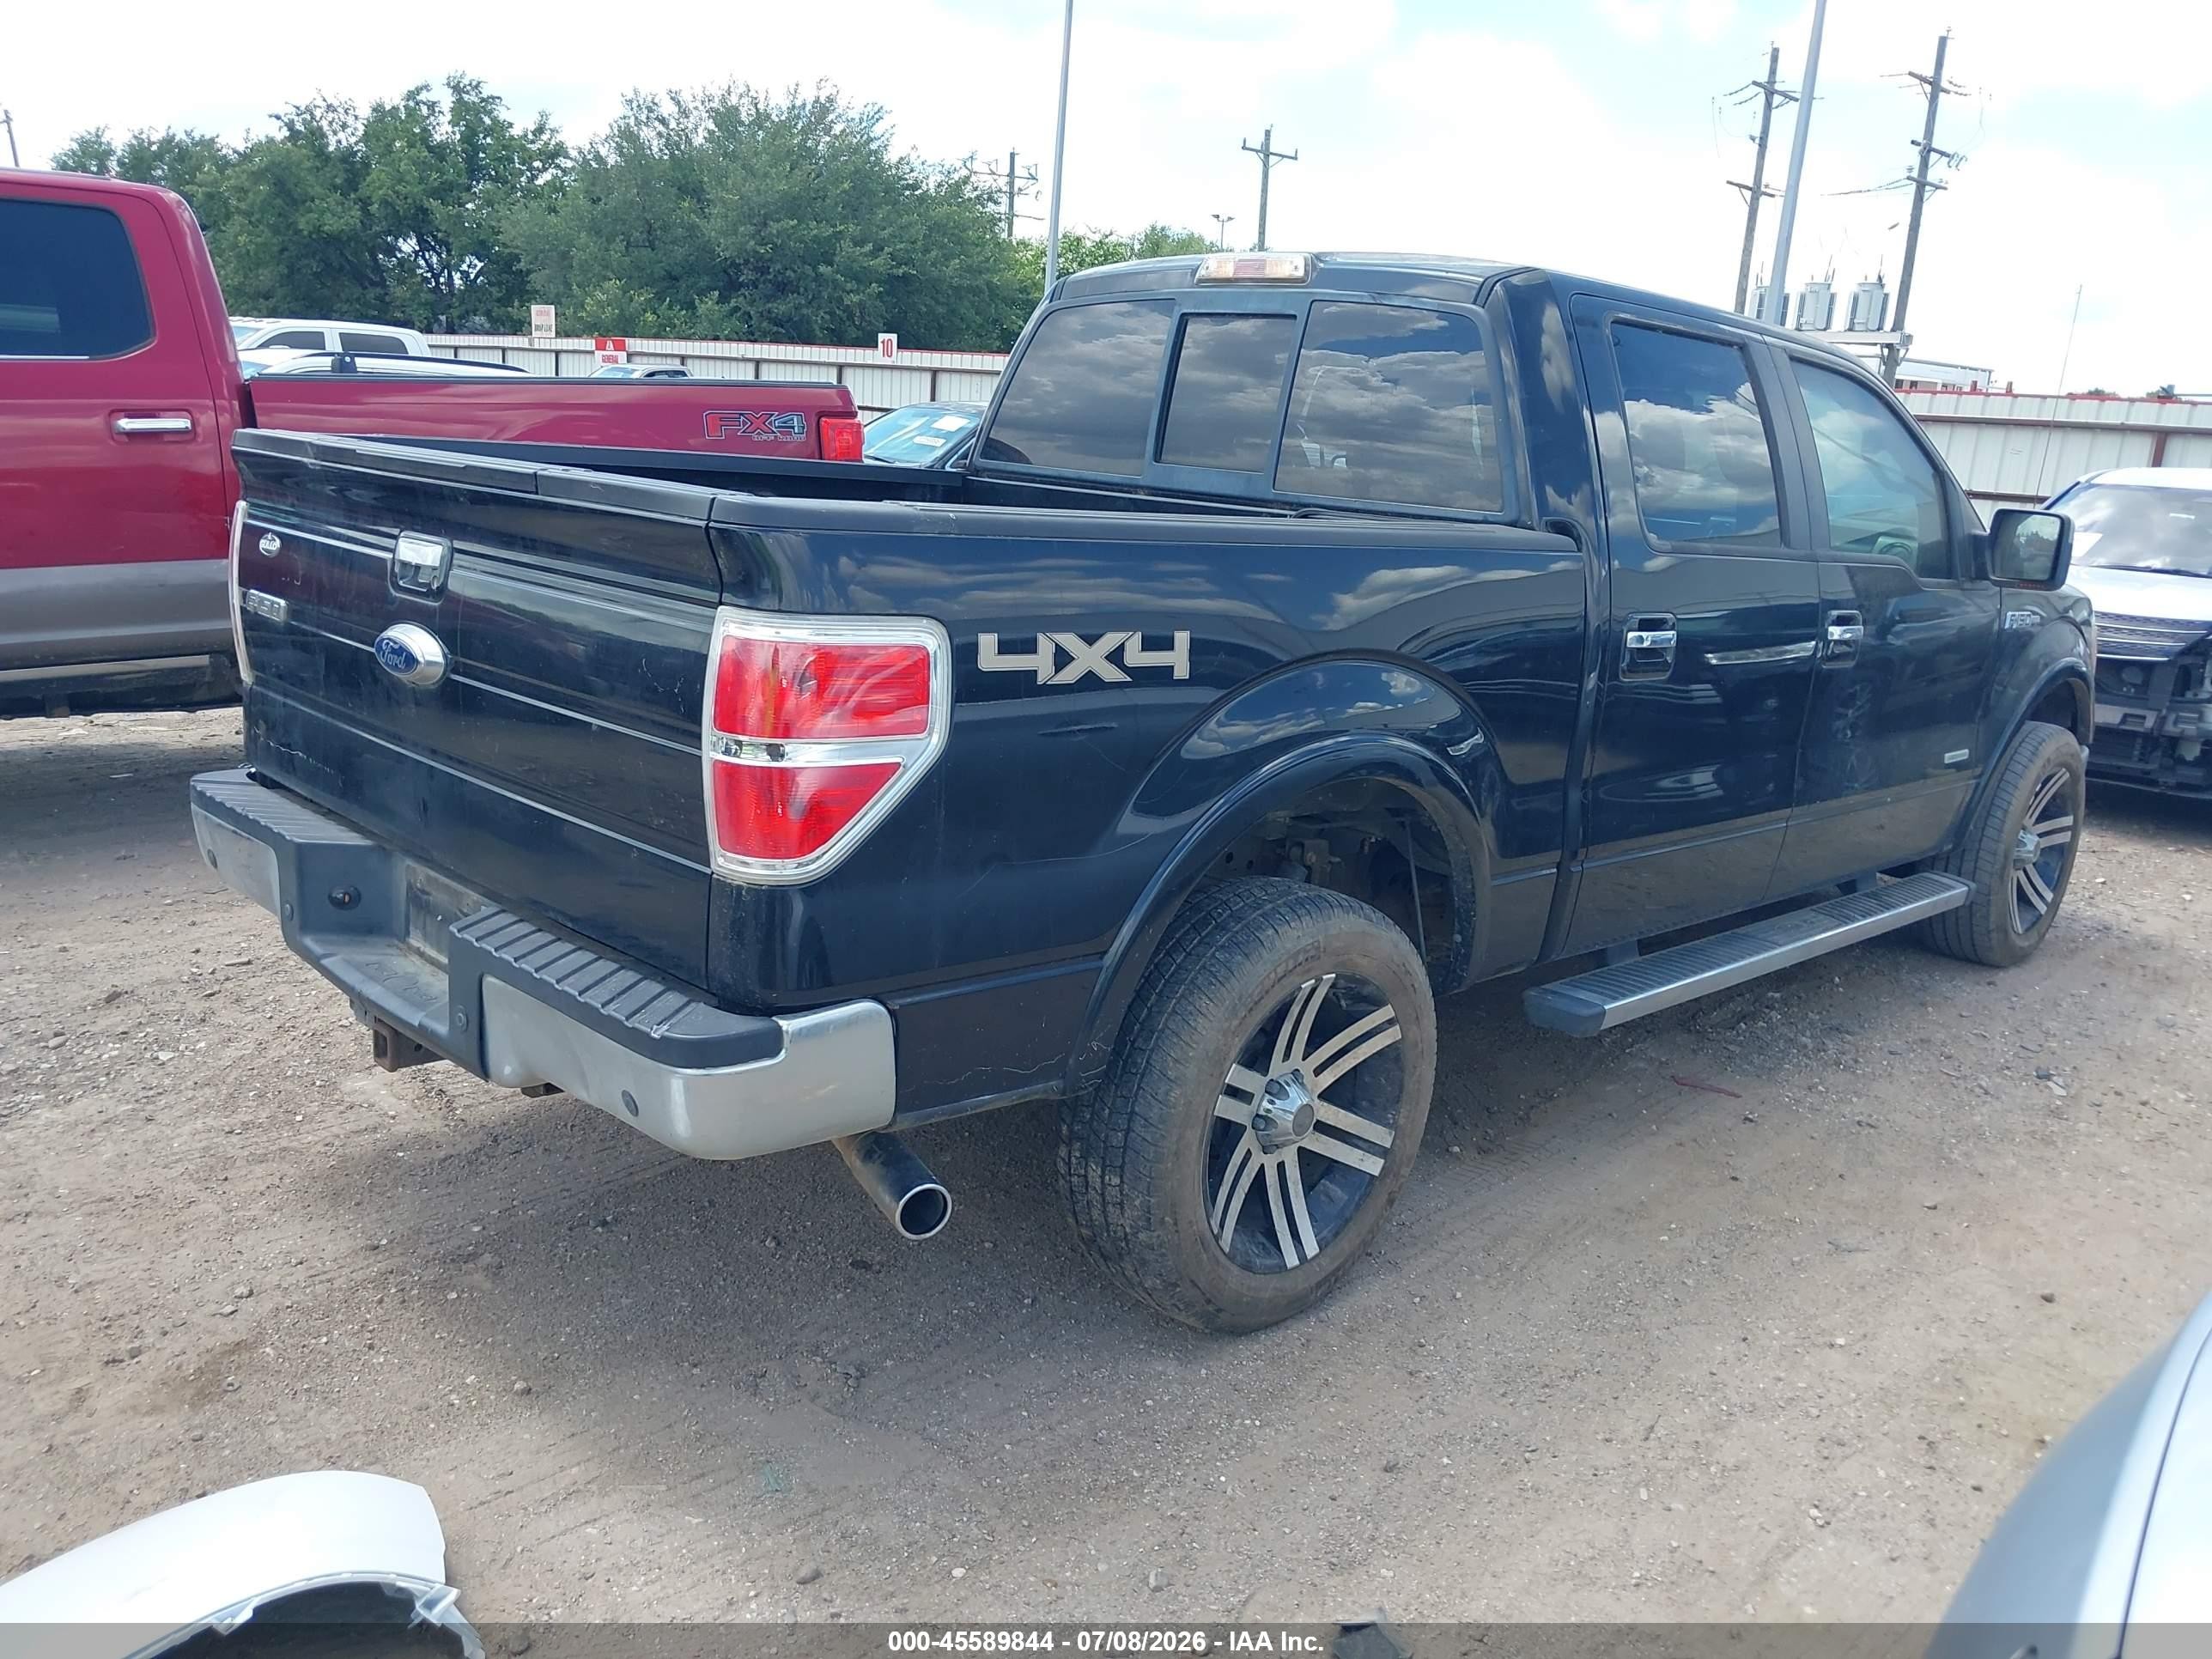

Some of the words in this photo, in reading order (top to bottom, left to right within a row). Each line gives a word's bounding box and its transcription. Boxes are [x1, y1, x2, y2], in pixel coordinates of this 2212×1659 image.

[880, 338, 893, 358] 10
[702, 410, 807, 440] FX4
[381, 640, 406, 669] Ford
[977, 630, 1191, 685] 4X4
